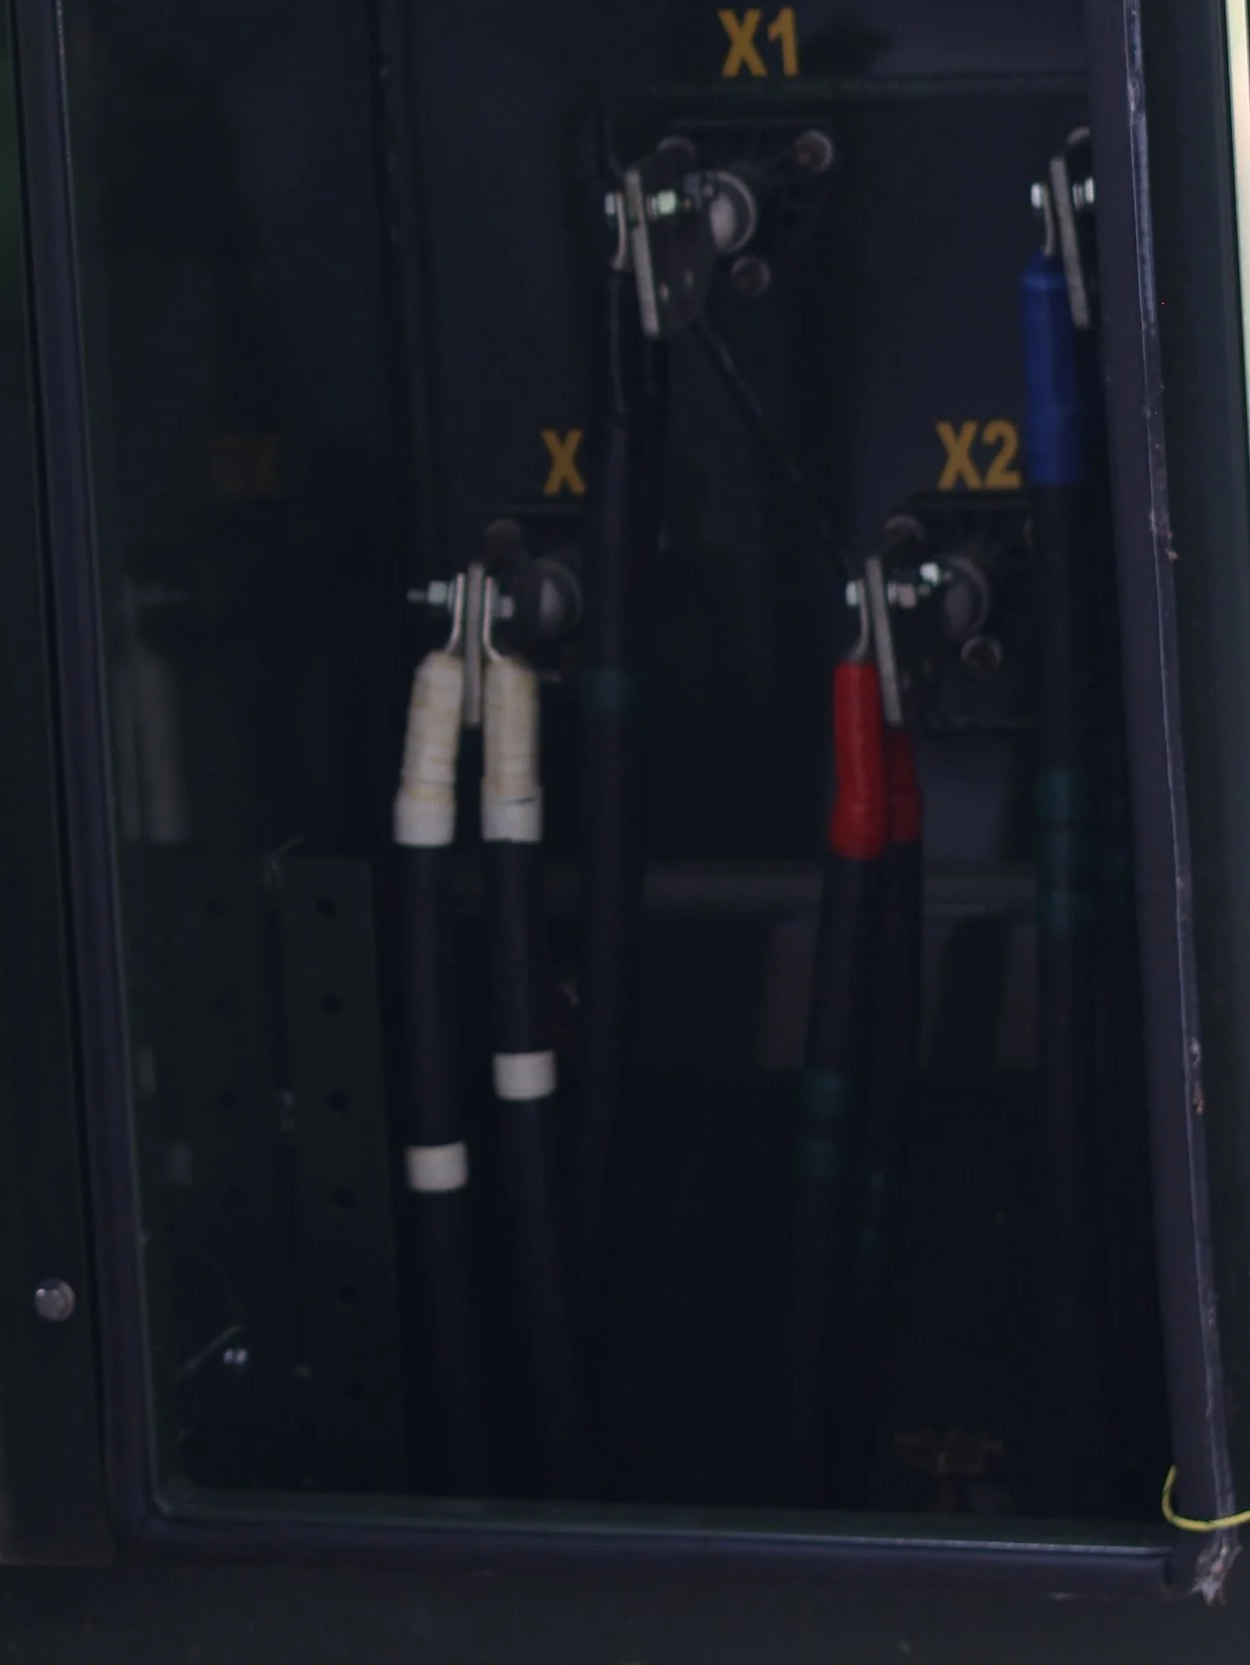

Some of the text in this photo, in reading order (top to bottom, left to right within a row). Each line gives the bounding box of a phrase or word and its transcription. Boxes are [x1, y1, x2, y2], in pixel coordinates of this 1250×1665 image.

[717, 7, 799, 78] X1
[541, 428, 586, 495] X
[936, 419, 1022, 490] X2
